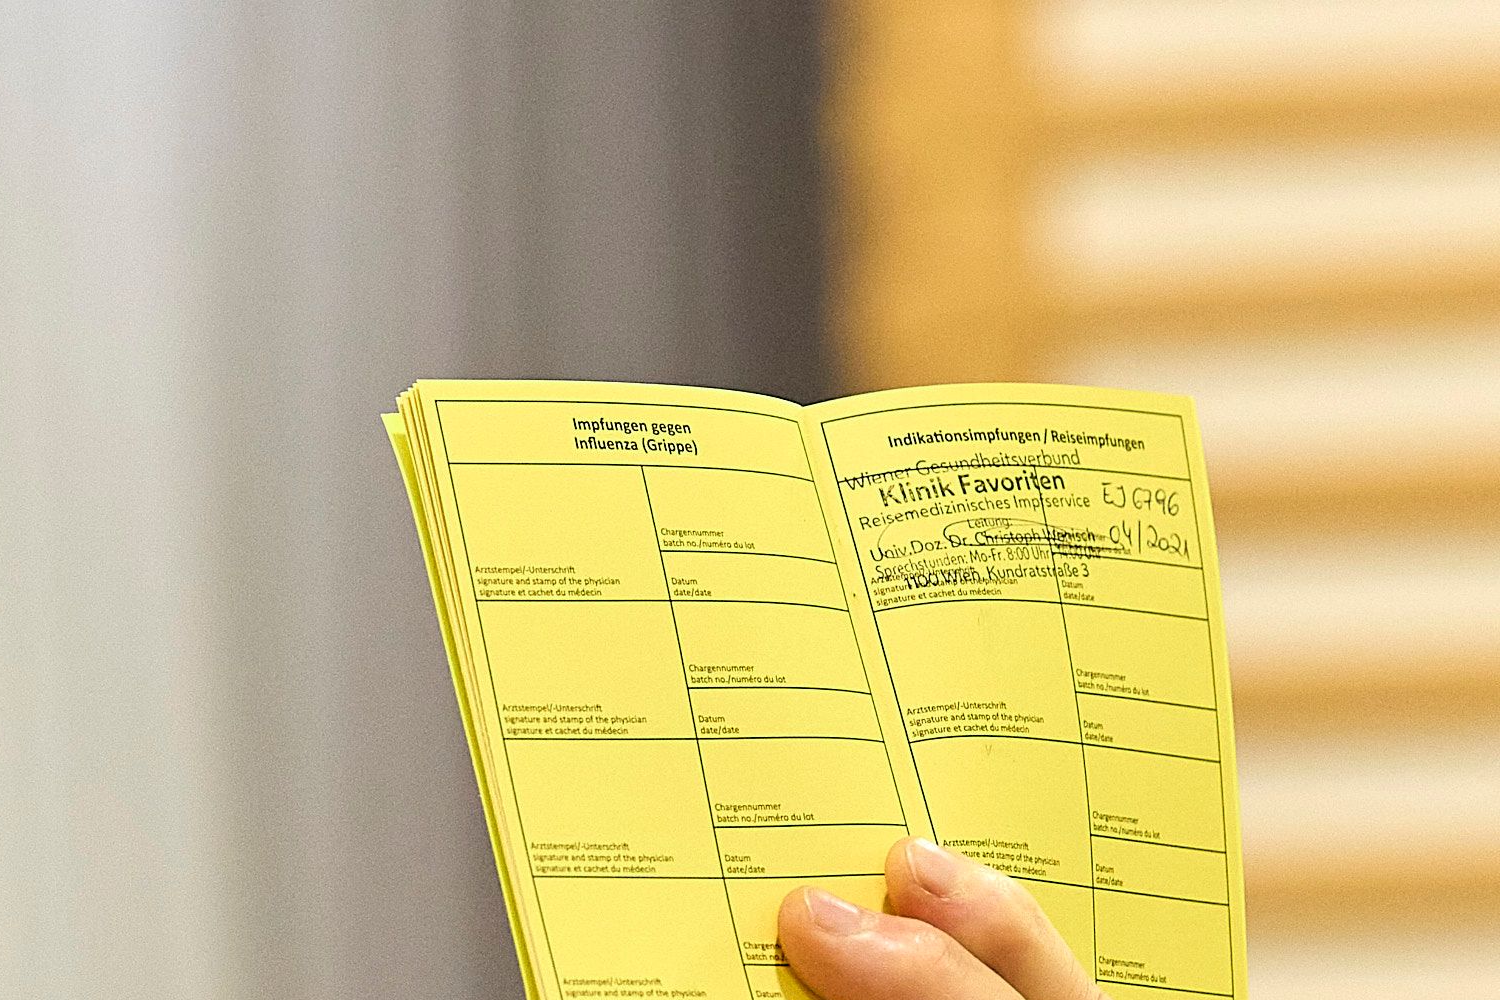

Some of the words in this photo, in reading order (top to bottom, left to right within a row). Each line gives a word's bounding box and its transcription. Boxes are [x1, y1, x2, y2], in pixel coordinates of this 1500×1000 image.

[573, 417, 648, 434] Impfungen
[652, 423, 691, 436] gegen
[888, 428, 1040, 448] Indikationsimpfungen
[1051, 430, 1145, 452] Reiseimpfungen
[575, 436, 638, 450] Influenza
[642, 437, 698, 456] (Grippe)
[844, 467, 911, 490] Wiener
[916, 449, 1080, 475] Gesundheitsverbund
[879, 477, 955, 507] Klinik
[958, 470, 1065, 495] Favoriten
[859, 497, 1010, 530] Reisemedizinisches
[967, 518, 1012, 529] Leitung:
[661, 528, 724, 537] Chargennummer
[950, 534, 973, 547] Dr.
[974, 529, 1041, 545] Christoph
[1109, 520, 1190, 562] 04/2021
[663, 539, 685, 547] batch
[875, 554, 968, 581] Sprechstunden:
[1007, 546, 1030, 561] 8:00
[1032, 546, 1050, 560] Uhr
[986, 562, 1078, 580] Kundratstraße
[1083, 563, 1090, 577] 3
[477, 578, 513, 586] signature
[516, 577, 530, 585] and
[532, 578, 557, 586] stamp
[558, 577, 566, 585] of
[569, 577, 582, 585] the
[584, 577, 621, 586] physician
[672, 577, 697, 585] Datum
[479, 589, 515, 597] signature
[556, 588, 566, 596] du
[568, 588, 602, 596] médecin
[674, 588, 711, 597] date/date
[876, 595, 915, 607] signature
[929, 590, 956, 598] cachet
[689, 664, 754, 673] Chargennummer
[714, 675, 762, 684] no./numéro
[504, 716, 540, 725] signature
[559, 716, 584, 724] stamp
[611, 716, 647, 725] physician
[698, 715, 725, 723] Datum
[909, 716, 948, 727] signature
[951, 713, 965, 721] and
[967, 713, 991, 721] stamp
[1014, 714, 1044, 723] physician
[700, 727, 739, 735] date/date
[912, 726, 951, 737] signature
[1001, 725, 1029, 733] médecin
[715, 803, 781, 812] Chargennummer
[717, 814, 739, 822] batch
[741, 814, 788, 823] no./numéro
[803, 813, 814, 821] lot
[533, 854, 568, 862] signature
[587, 854, 612, 862] stamp
[623, 854, 636, 862] the
[638, 854, 674, 863] physician
[996, 852, 1014, 860] stamp
[1016, 853, 1022, 861] of
[1023, 854, 1033, 862] the
[1034, 855, 1060, 866] physician
[584, 865, 608, 873] cachet
[612, 865, 621, 873] du
[727, 866, 765, 874] date/date
[1014, 864, 1021, 872] du
[747, 952, 768, 960] batch
[756, 990, 781, 998] Datum
